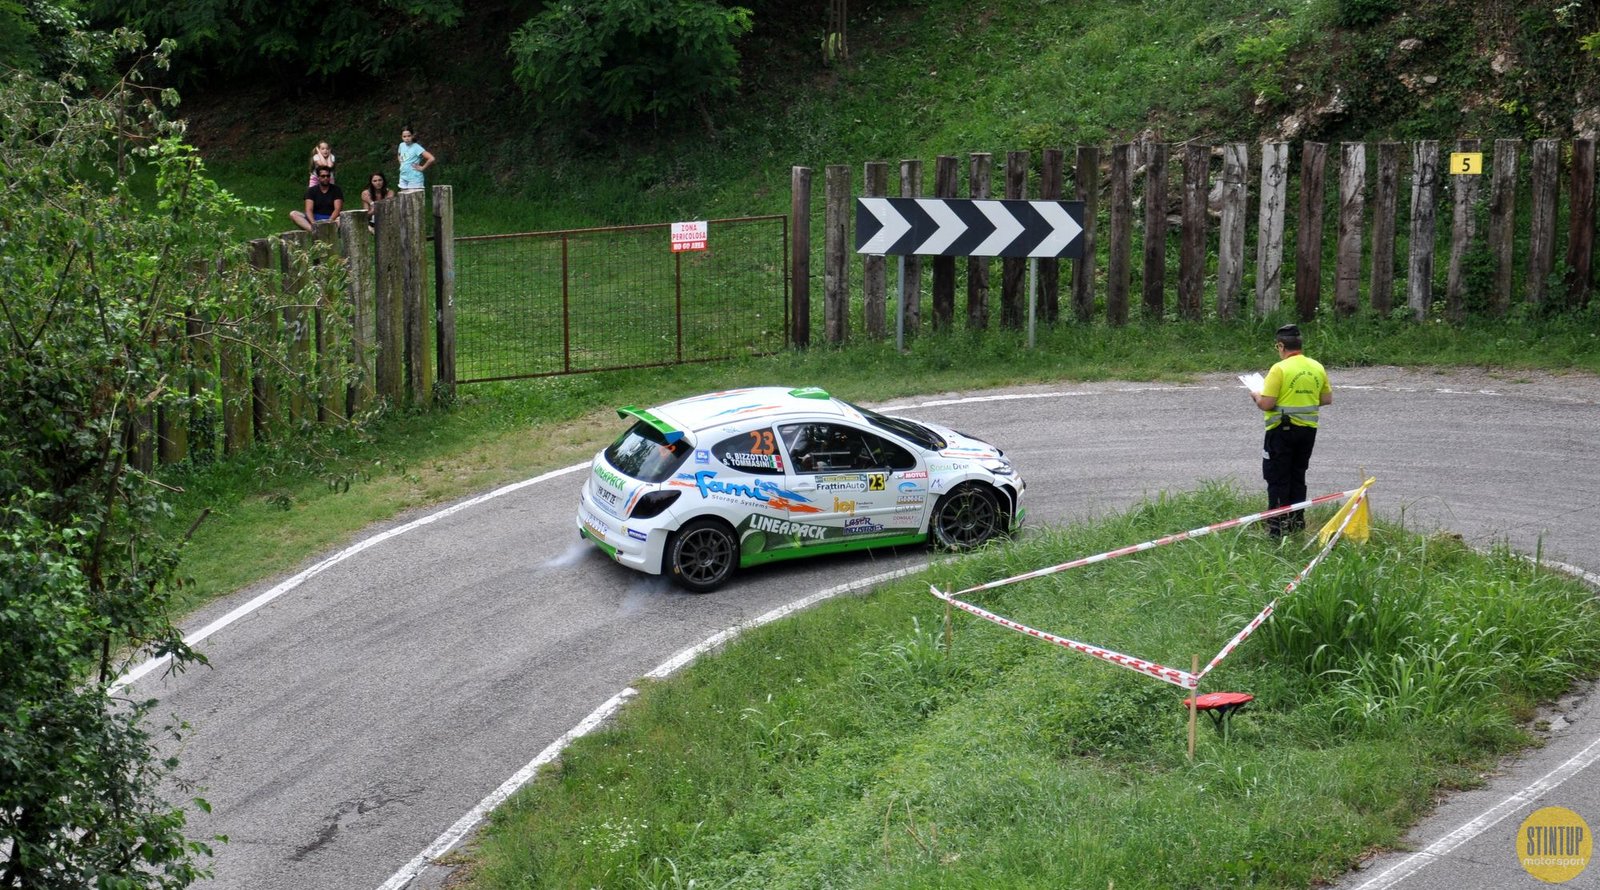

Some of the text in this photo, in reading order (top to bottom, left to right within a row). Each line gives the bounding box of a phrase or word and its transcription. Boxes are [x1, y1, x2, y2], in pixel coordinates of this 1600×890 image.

[1462, 157, 1471, 172] 5
[672, 232, 706, 240] PERICOLOSA
[750, 431, 775, 454] 23
[722, 458, 771, 468] S. TOMMASINI
[725, 452, 769, 461] G. BIZZOTTO
[594, 463, 627, 491] LINEAPACK
[869, 474, 884, 490] 23
[695, 470, 771, 502] Fami
[712, 494, 768, 509] Storage Systems
[749, 512, 828, 540] LINEAPACK
